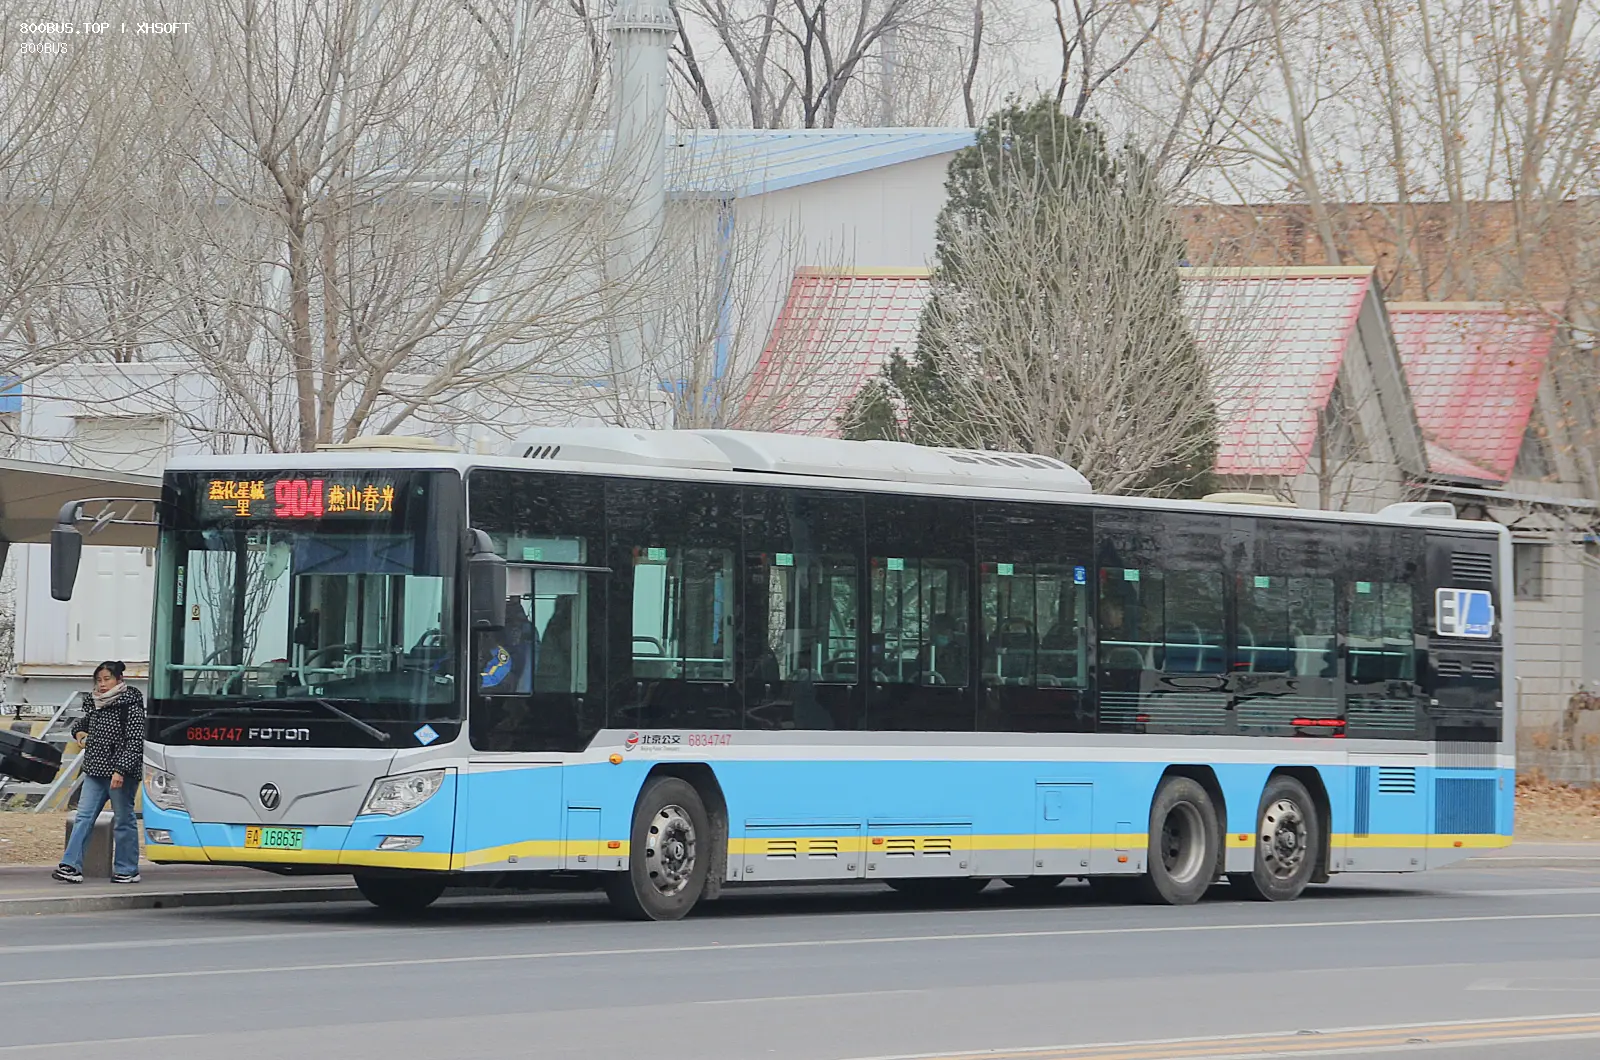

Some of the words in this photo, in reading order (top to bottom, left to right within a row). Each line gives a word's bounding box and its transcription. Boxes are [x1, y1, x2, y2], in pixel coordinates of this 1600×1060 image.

[275, 479, 324, 516] 904
[328, 484, 394, 512] 燕山春光
[222, 499, 252, 517] 一里
[186, 727, 243, 742] 6834747
[248, 727, 310, 741] FOTON
[641, 734, 681, 745] 北京公交
[688, 734, 731, 746] 6834747
